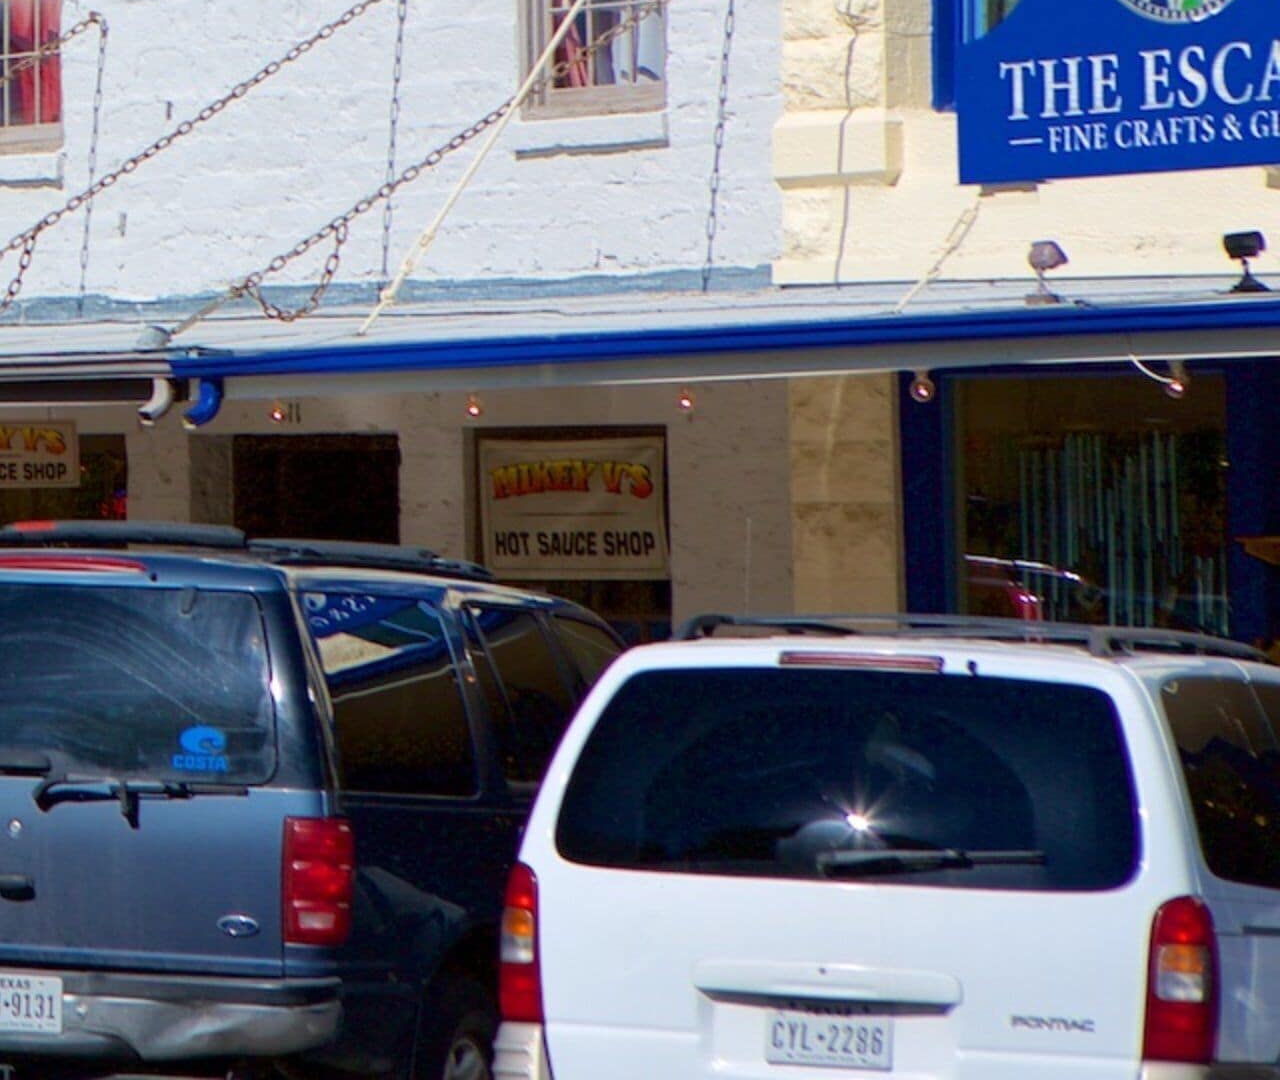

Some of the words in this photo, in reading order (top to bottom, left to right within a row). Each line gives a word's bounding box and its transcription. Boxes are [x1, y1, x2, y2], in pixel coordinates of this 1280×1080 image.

[1000, 54, 1122, 120] THE
[1139, 40, 1280, 110] ESCA
[1048, 123, 1108, 153] FINE
[1114, 115, 1215, 149] CRAFTS
[1222, 113, 1243, 141] &
[23, 463, 67, 481] SHOP
[493, 459, 596, 499] MIKEY
[495, 532, 529, 557] HOT
[537, 532, 597, 557] SAUCE
[603, 532, 655, 557] SHOP
[172, 755, 228, 770] COSTA
[1011, 1015, 1095, 1033] PONTIAC
